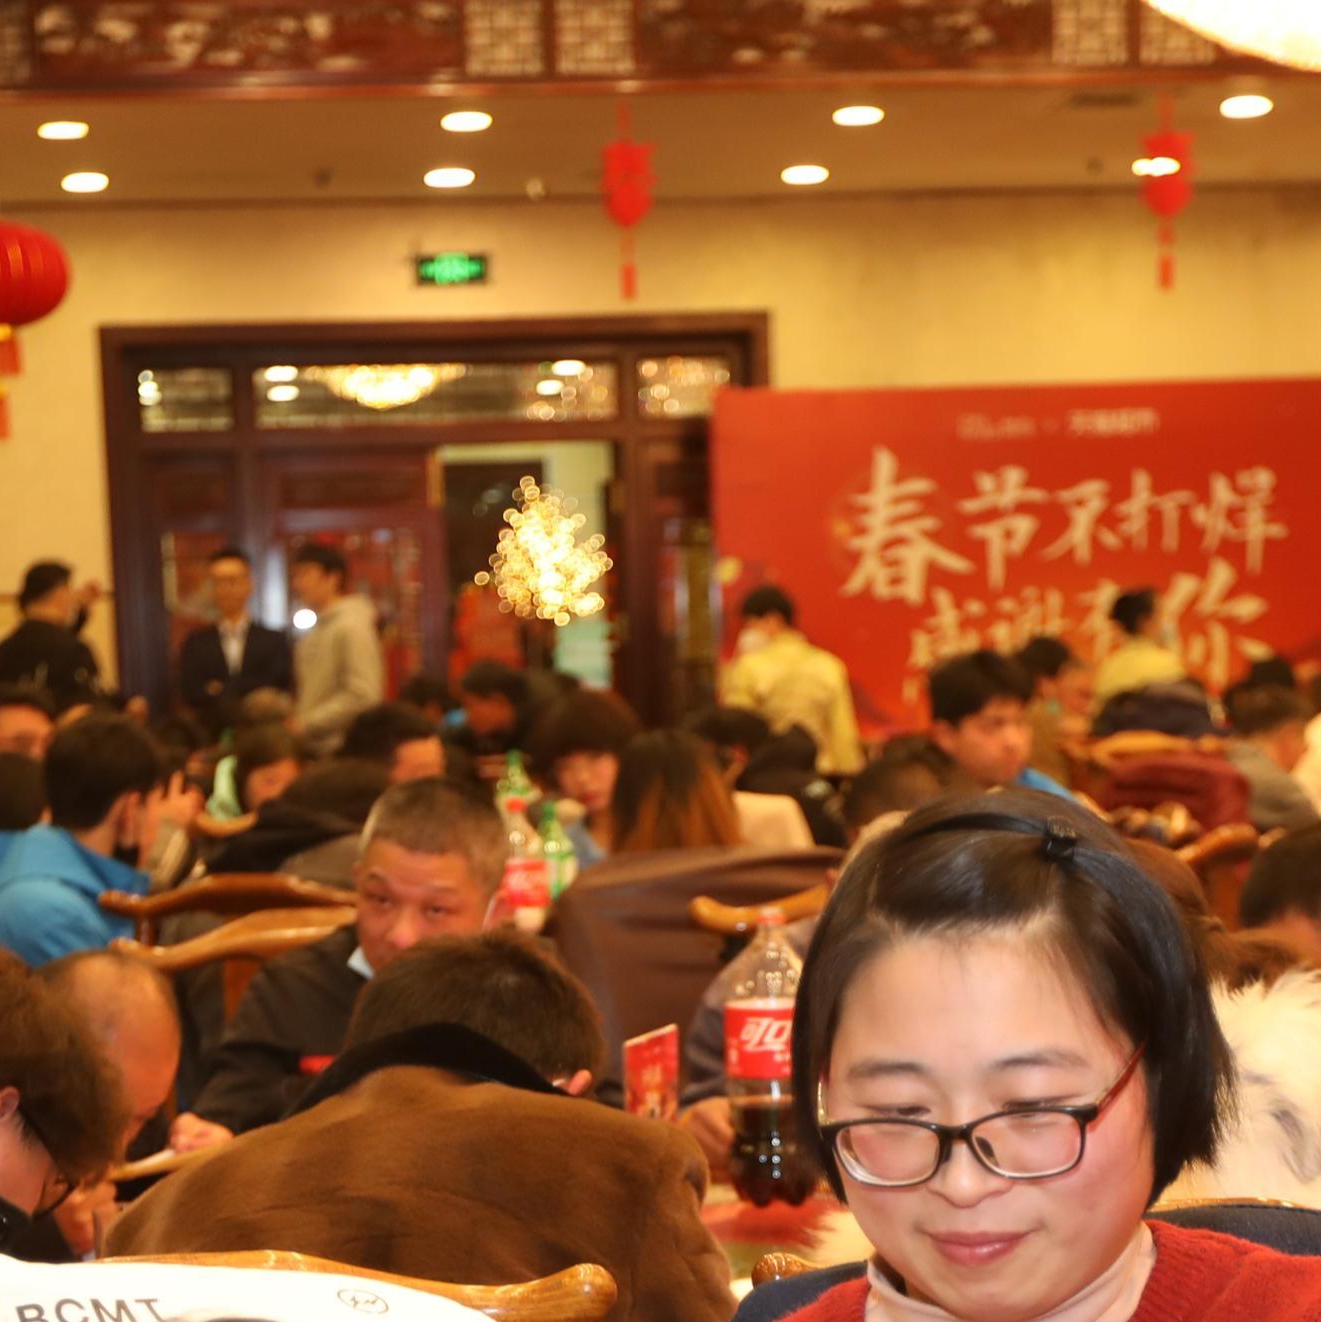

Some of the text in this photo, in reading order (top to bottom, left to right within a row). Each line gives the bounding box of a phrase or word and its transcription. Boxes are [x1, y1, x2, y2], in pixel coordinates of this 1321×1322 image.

[840, 445, 1289, 605] 春节不打烊
